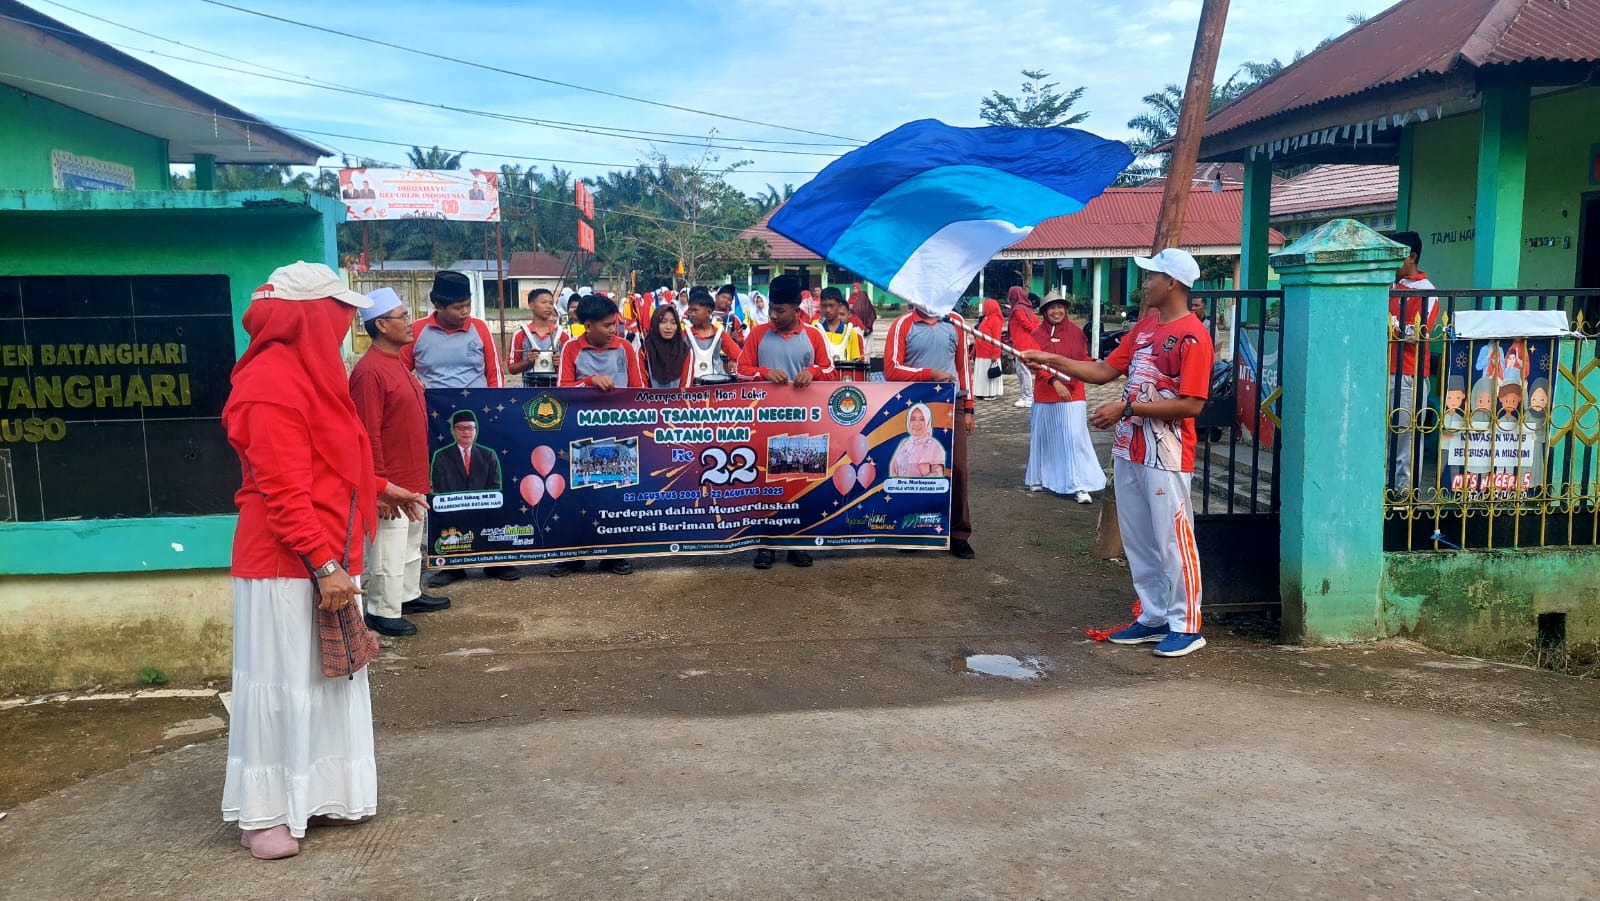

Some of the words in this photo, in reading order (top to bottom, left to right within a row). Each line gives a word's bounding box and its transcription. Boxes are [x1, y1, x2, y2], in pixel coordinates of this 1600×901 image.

[1431, 231, 1457, 244] TAMU
[1001, 248, 1034, 258] GERAI
[1037, 247, 1066, 258] BACA
[1110, 246, 1139, 256] NEGERI
[40, 342, 188, 367] BATANGHARI
[634, 391, 711, 405] Memperingati
[715, 388, 737, 401] Hari
[741, 387, 768, 401] Lahir
[577, 408, 657, 426] MADRASAH
[660, 407, 755, 423] TSANAWIYAH
[758, 407, 807, 422] NEGERI
[810, 408, 822, 421] 5
[653, 427, 714, 443] BATANG
[716, 426, 752, 442] HARI
[671, 448, 695, 464] Ke
[700, 446, 760, 486] 22
[1523, 471, 1532, 489] 5
[623, 492, 636, 502] 22
[638, 491, 677, 501] AGUSTUS
[680, 490, 701, 500] 2003
[711, 489, 722, 499] 22
[724, 487, 761, 498] AGUSTUS
[762, 486, 784, 496] 2025
[598, 508, 663, 520] Terdepan
[665, 506, 706, 517] dalam
[708, 502, 800, 516] Mencerdaskan
[595, 522, 657, 535] Generasi
[658, 521, 715, 532] Beriman
[717, 519, 741, 529] dan
[742, 515, 801, 527] Bertaqwa
